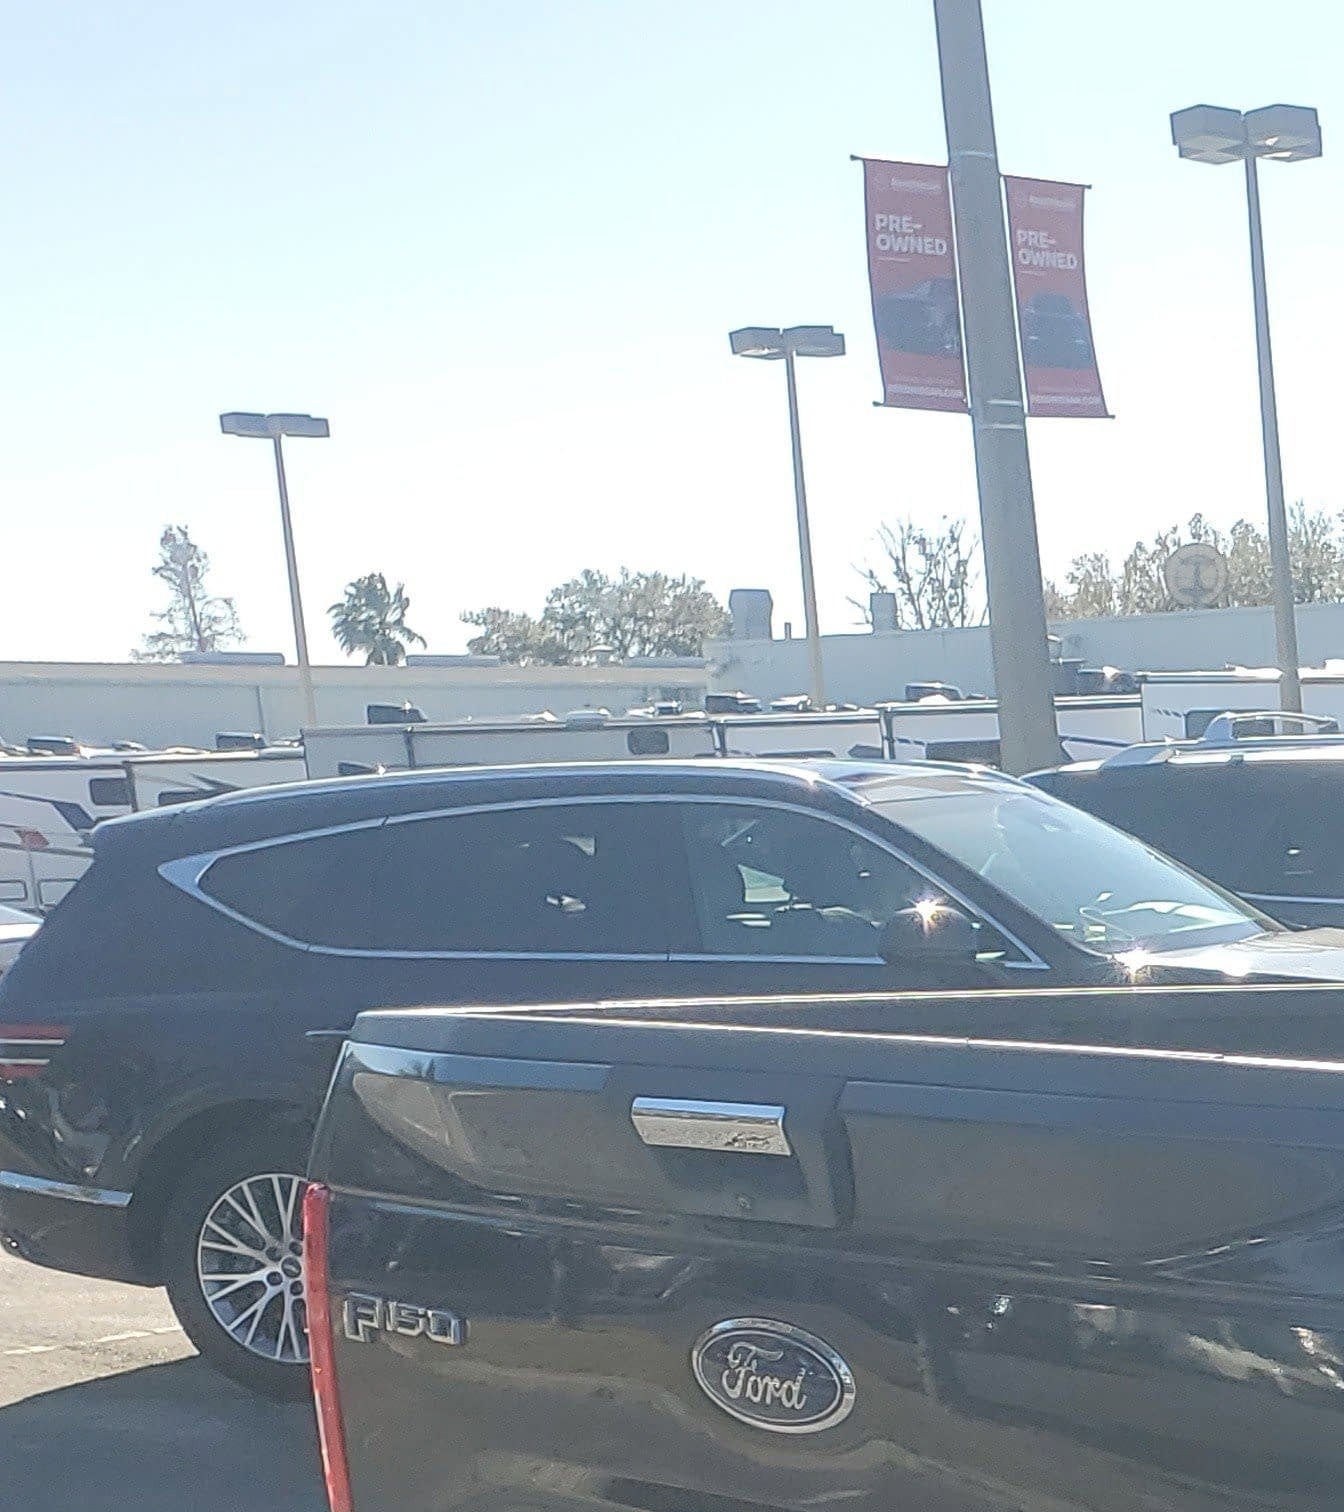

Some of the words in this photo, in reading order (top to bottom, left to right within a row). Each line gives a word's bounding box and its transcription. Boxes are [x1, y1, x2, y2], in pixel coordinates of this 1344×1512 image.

[875, 213, 921, 232] PRE-
[876, 233, 947, 256] OWNED
[1017, 229, 1056, 248] PRE-
[1018, 247, 1078, 270] OWNED
[721, 1341, 808, 1412] Ford
